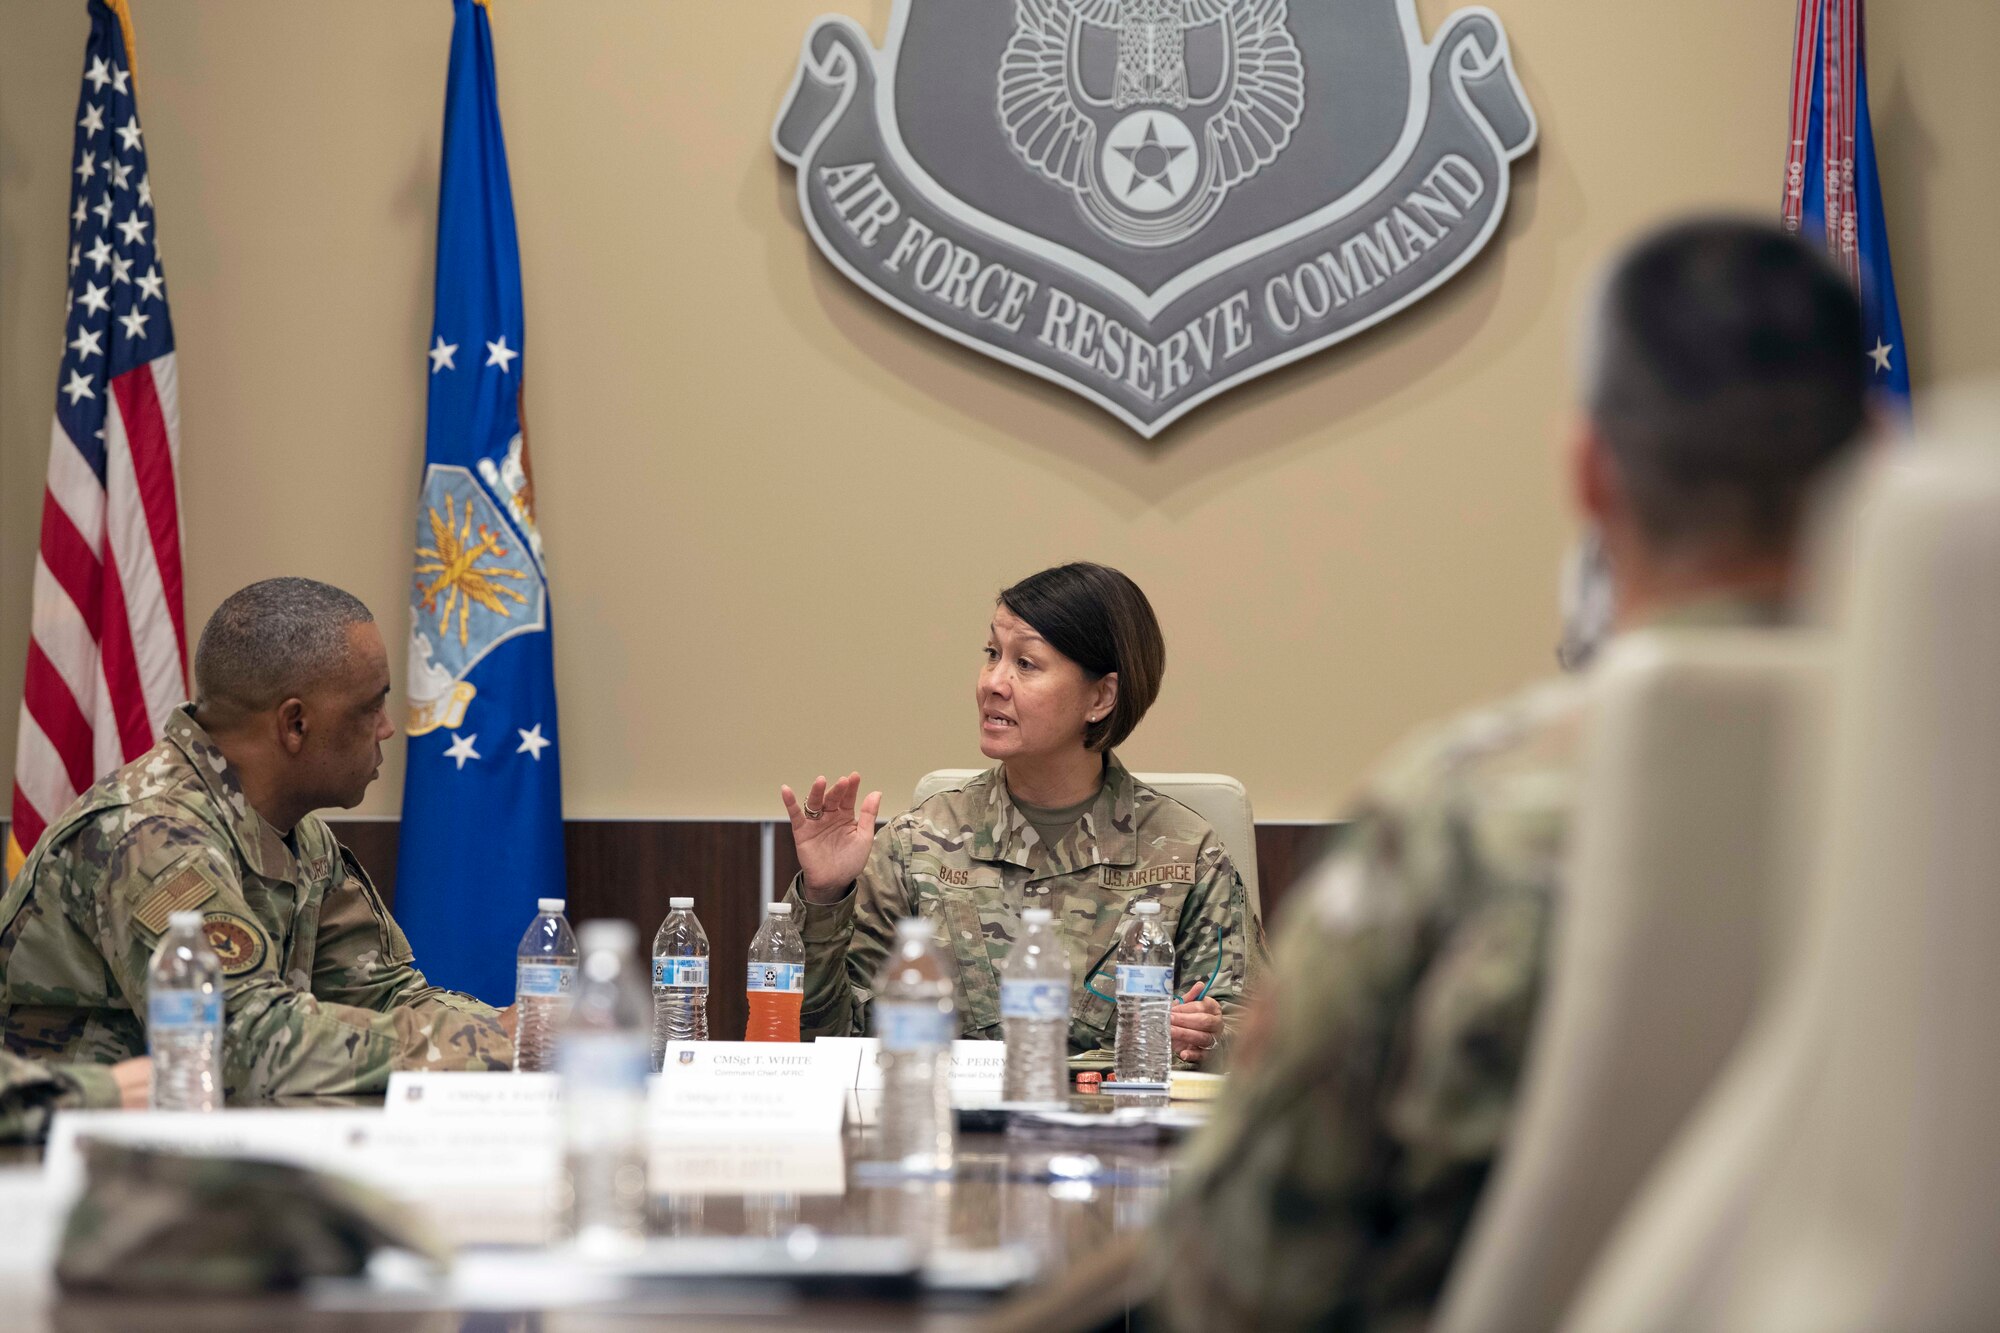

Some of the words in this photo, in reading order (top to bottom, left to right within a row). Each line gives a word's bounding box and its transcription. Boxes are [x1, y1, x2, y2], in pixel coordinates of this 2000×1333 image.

[1788, 161, 1802, 196] OCT
[819, 161, 900, 248] AIR
[883, 217, 1038, 333] FORCE
[1038, 287, 1253, 401] RESERVE
[1265, 153, 1485, 333] COMMAND
[940, 865, 968, 885] BASS
[1103, 868, 1124, 887] U.S.
[1126, 869, 1147, 887] AIR
[1149, 865, 1191, 883] FORCE
[713, 1055, 750, 1066] CMSgt
[754, 1055, 764, 1065] T.
[769, 1055, 813, 1065] WHITE
[950, 1056, 962, 1066] N.
[967, 1056, 1007, 1067] PERRY
[714, 1069, 755, 1077] Command
[948, 1071, 977, 1079] Special
[979, 1071, 996, 1080] Duty
